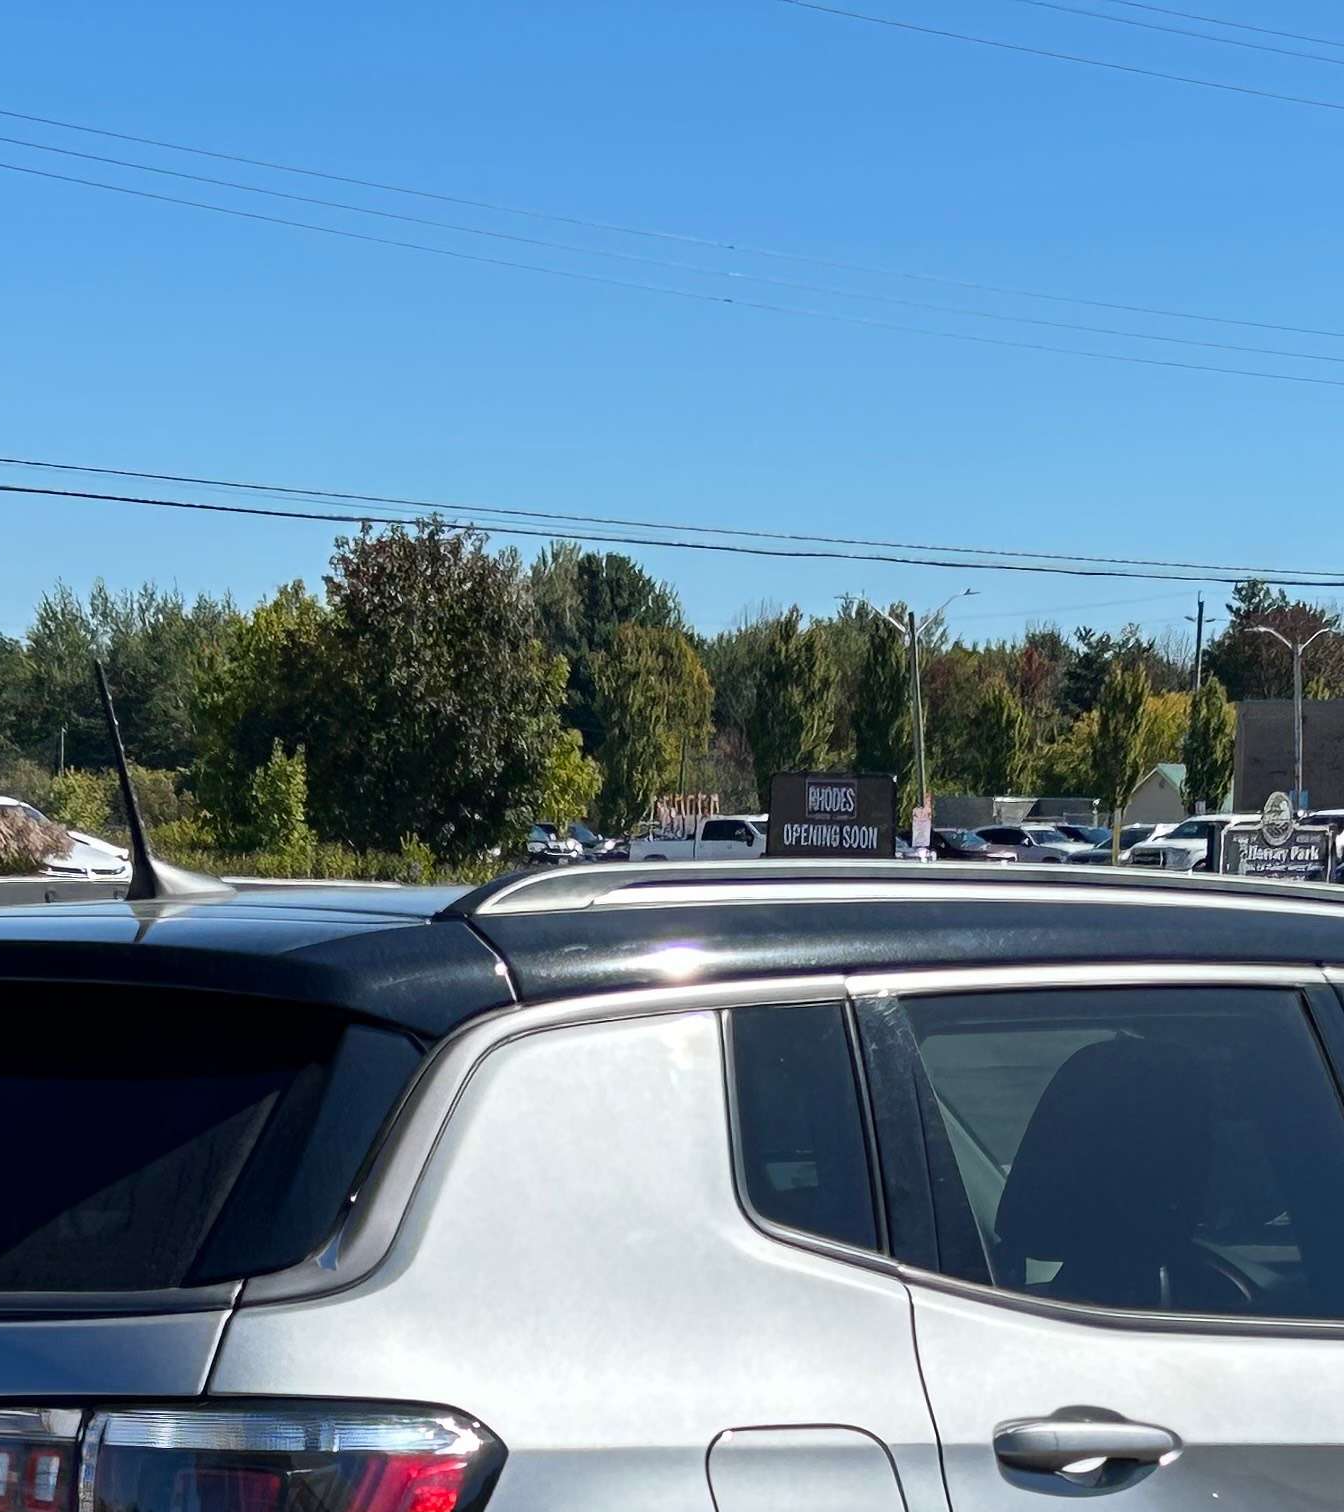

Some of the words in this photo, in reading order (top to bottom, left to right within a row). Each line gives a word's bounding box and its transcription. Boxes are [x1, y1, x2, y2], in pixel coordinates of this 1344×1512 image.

[808, 785, 855, 812] RHODES
[783, 823, 841, 848] OPENING
[842, 825, 878, 849] SOON
